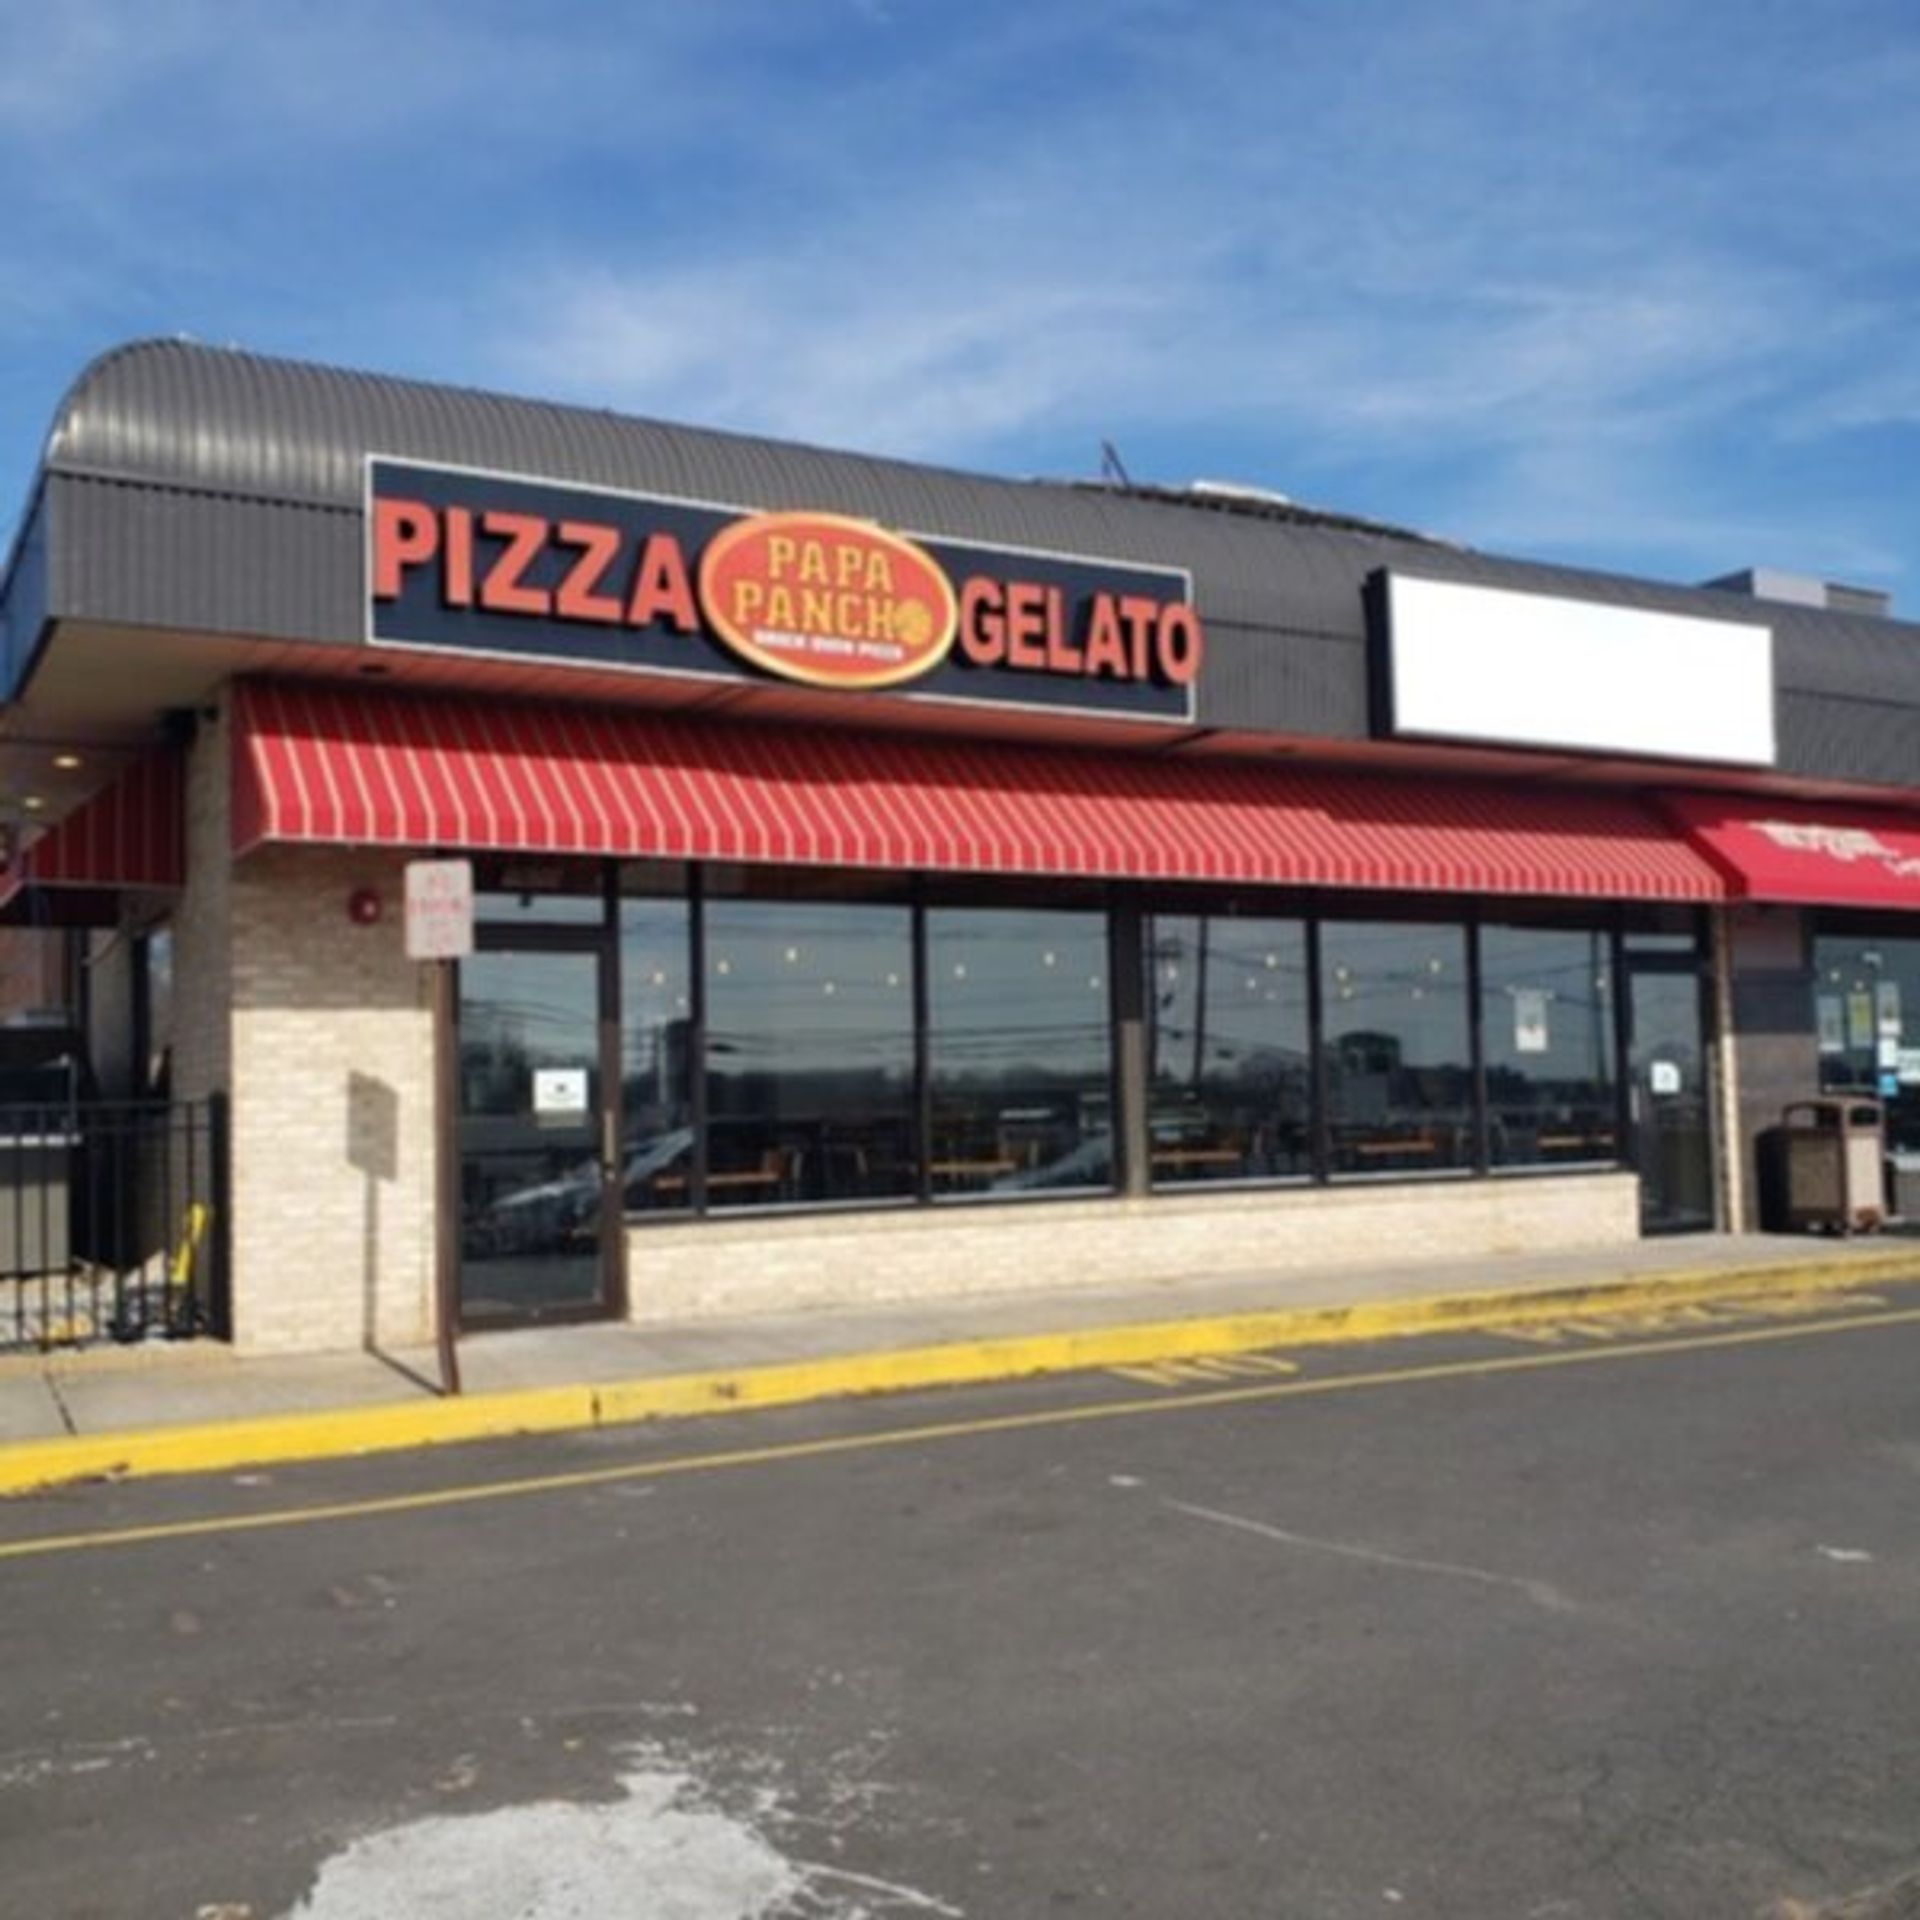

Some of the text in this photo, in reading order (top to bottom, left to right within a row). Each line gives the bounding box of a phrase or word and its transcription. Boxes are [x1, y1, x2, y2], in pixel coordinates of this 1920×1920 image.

[375, 499, 699, 631] PIZZA
[768, 536, 892, 592] PAPA
[960, 576, 1202, 685] GELATO
